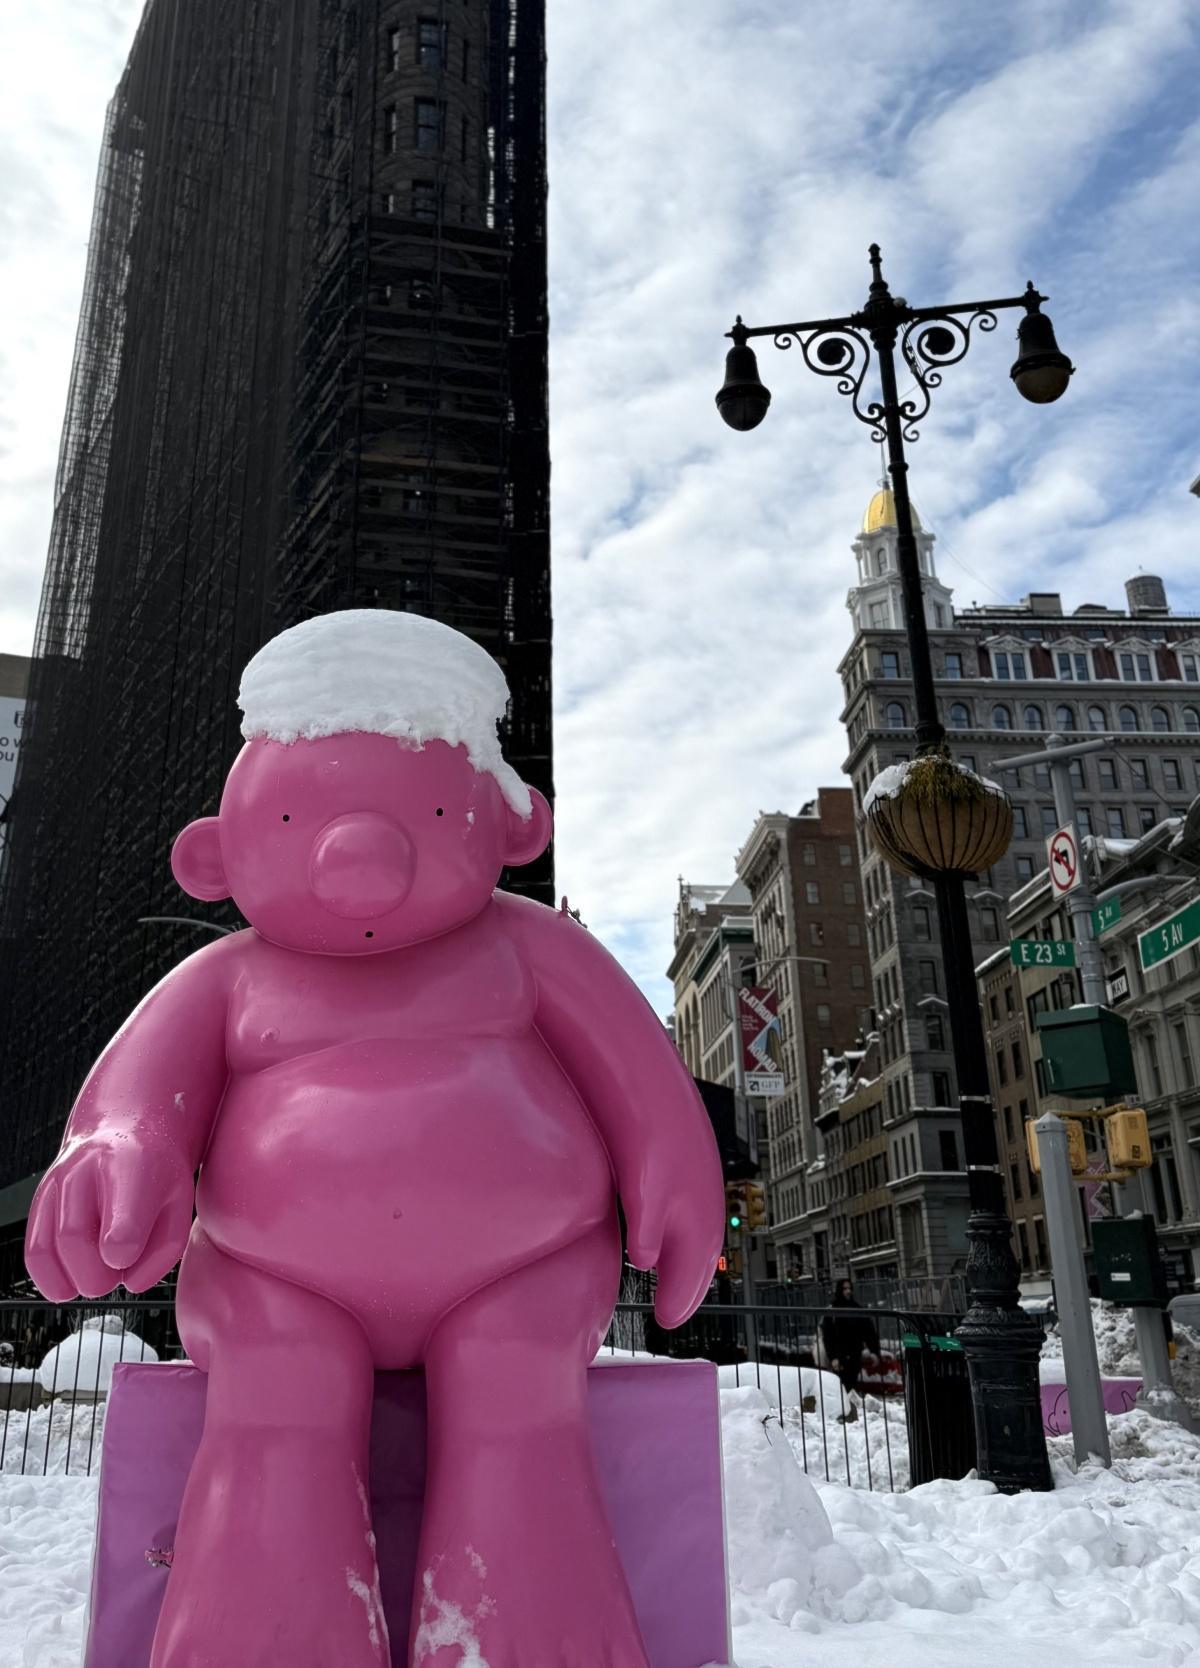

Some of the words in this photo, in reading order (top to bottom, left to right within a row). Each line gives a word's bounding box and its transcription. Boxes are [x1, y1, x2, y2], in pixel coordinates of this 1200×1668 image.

[1098, 910, 1105, 929] 5
[1162, 929, 1169, 952] 5
[1021, 944, 1031, 962] E
[1034, 944, 1053, 963] 23
[1056, 943, 1066, 956] St
[738, 988, 775, 1023] FLATIRON
